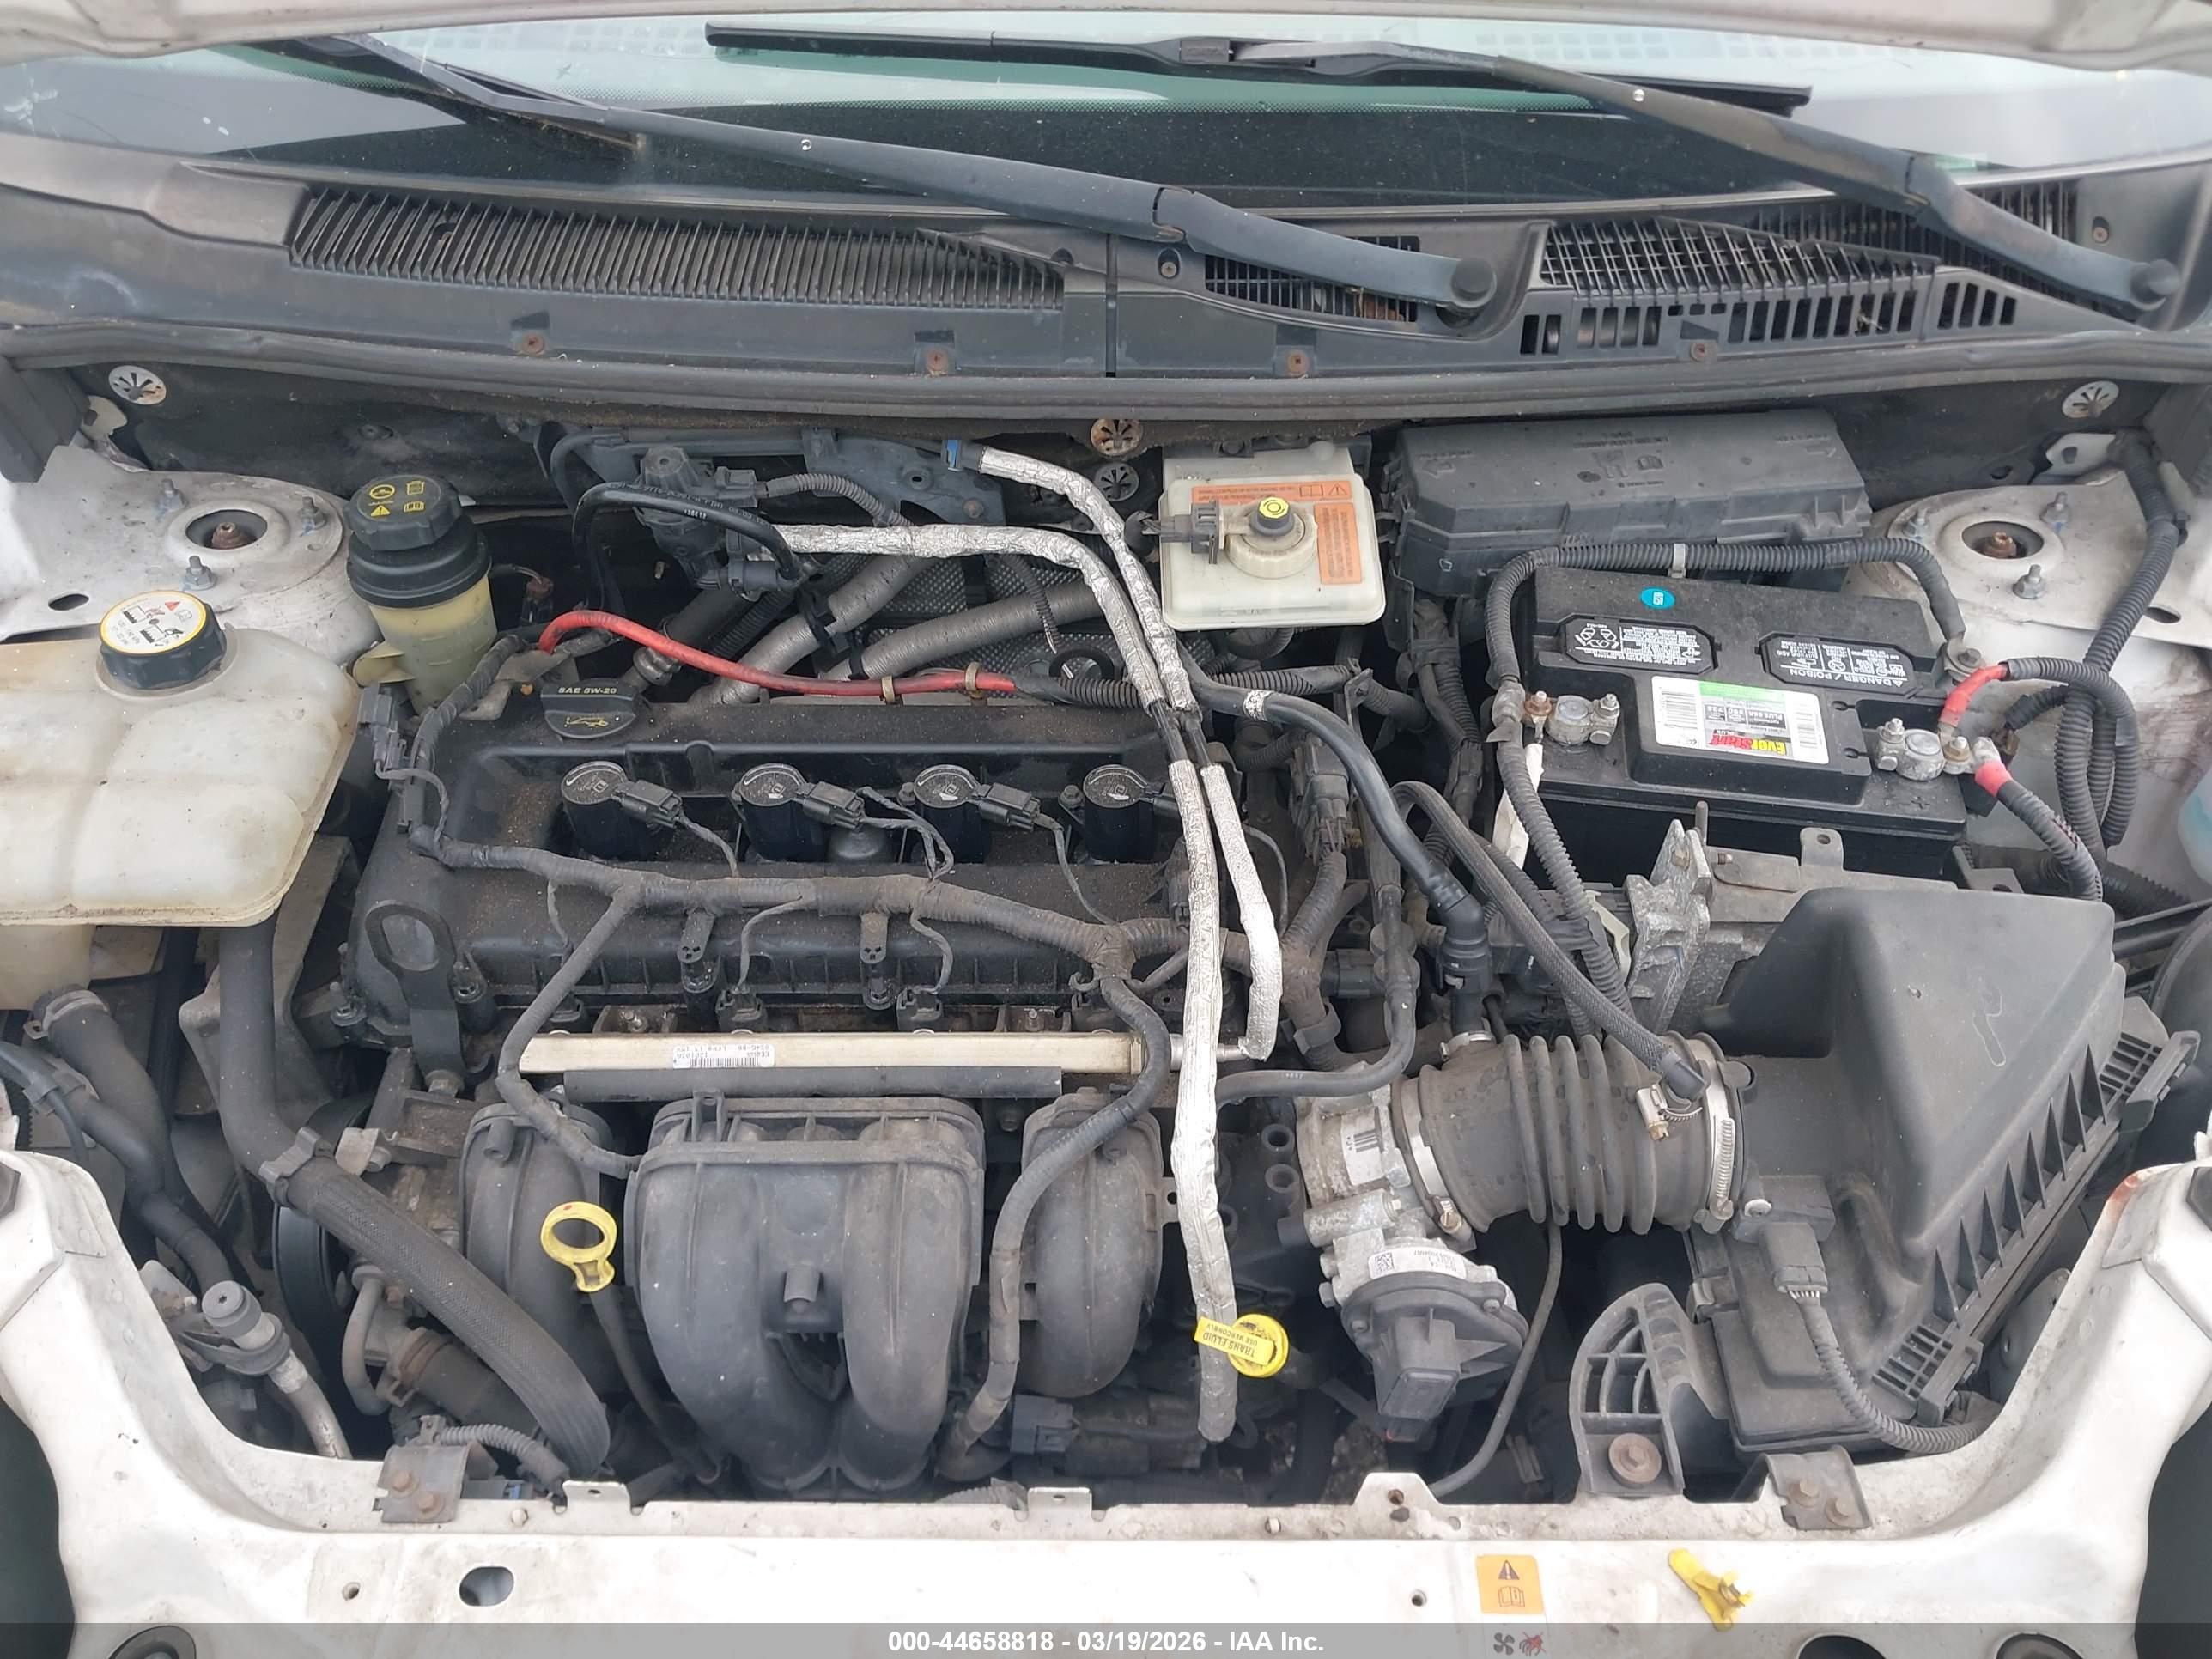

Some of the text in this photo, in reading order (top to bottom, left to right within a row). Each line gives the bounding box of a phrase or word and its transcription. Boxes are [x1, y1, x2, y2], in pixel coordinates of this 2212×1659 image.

[1790, 668, 1832, 680] POISON
[1845, 674, 1890, 687] DANGER
[1708, 735, 1786, 755] EverStart
